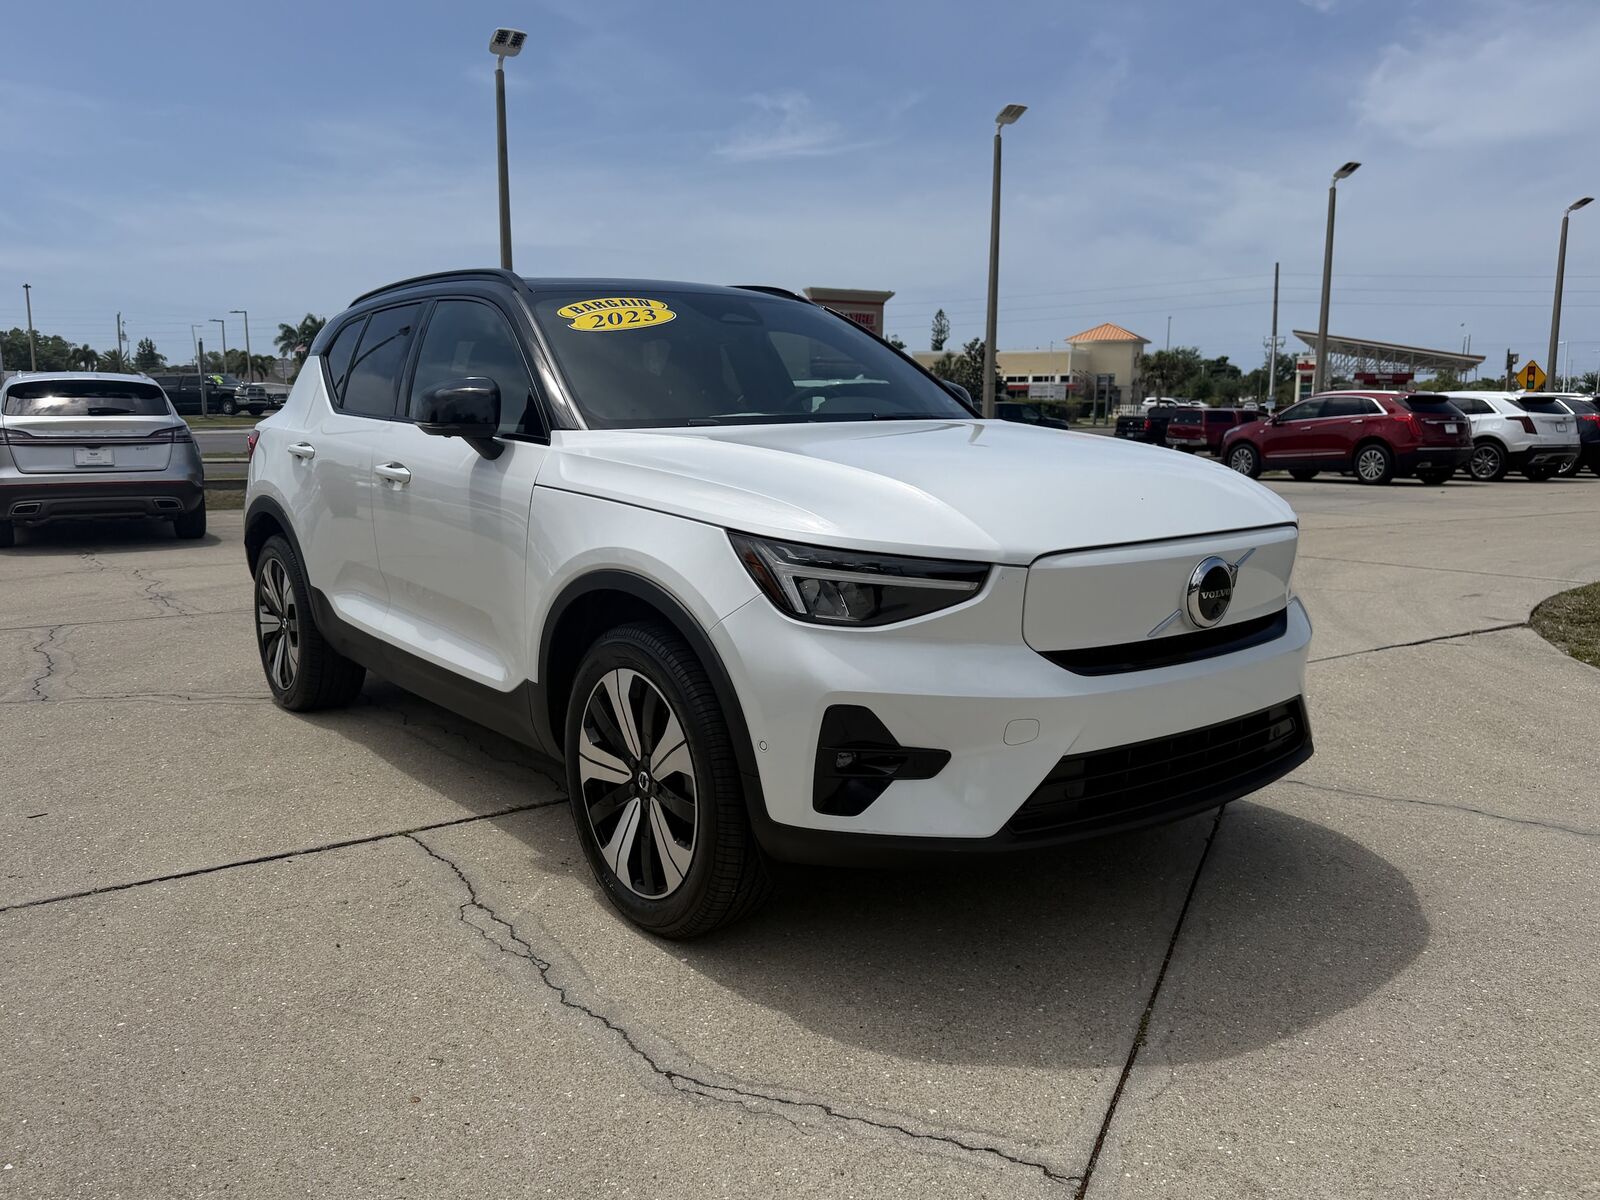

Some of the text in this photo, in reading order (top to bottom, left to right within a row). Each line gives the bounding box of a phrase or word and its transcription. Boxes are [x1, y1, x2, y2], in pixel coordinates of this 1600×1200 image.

[568, 299, 652, 315] BARGAIN
[590, 309, 657, 329] 2023
[1201, 588, 1231, 599] VOLVO
